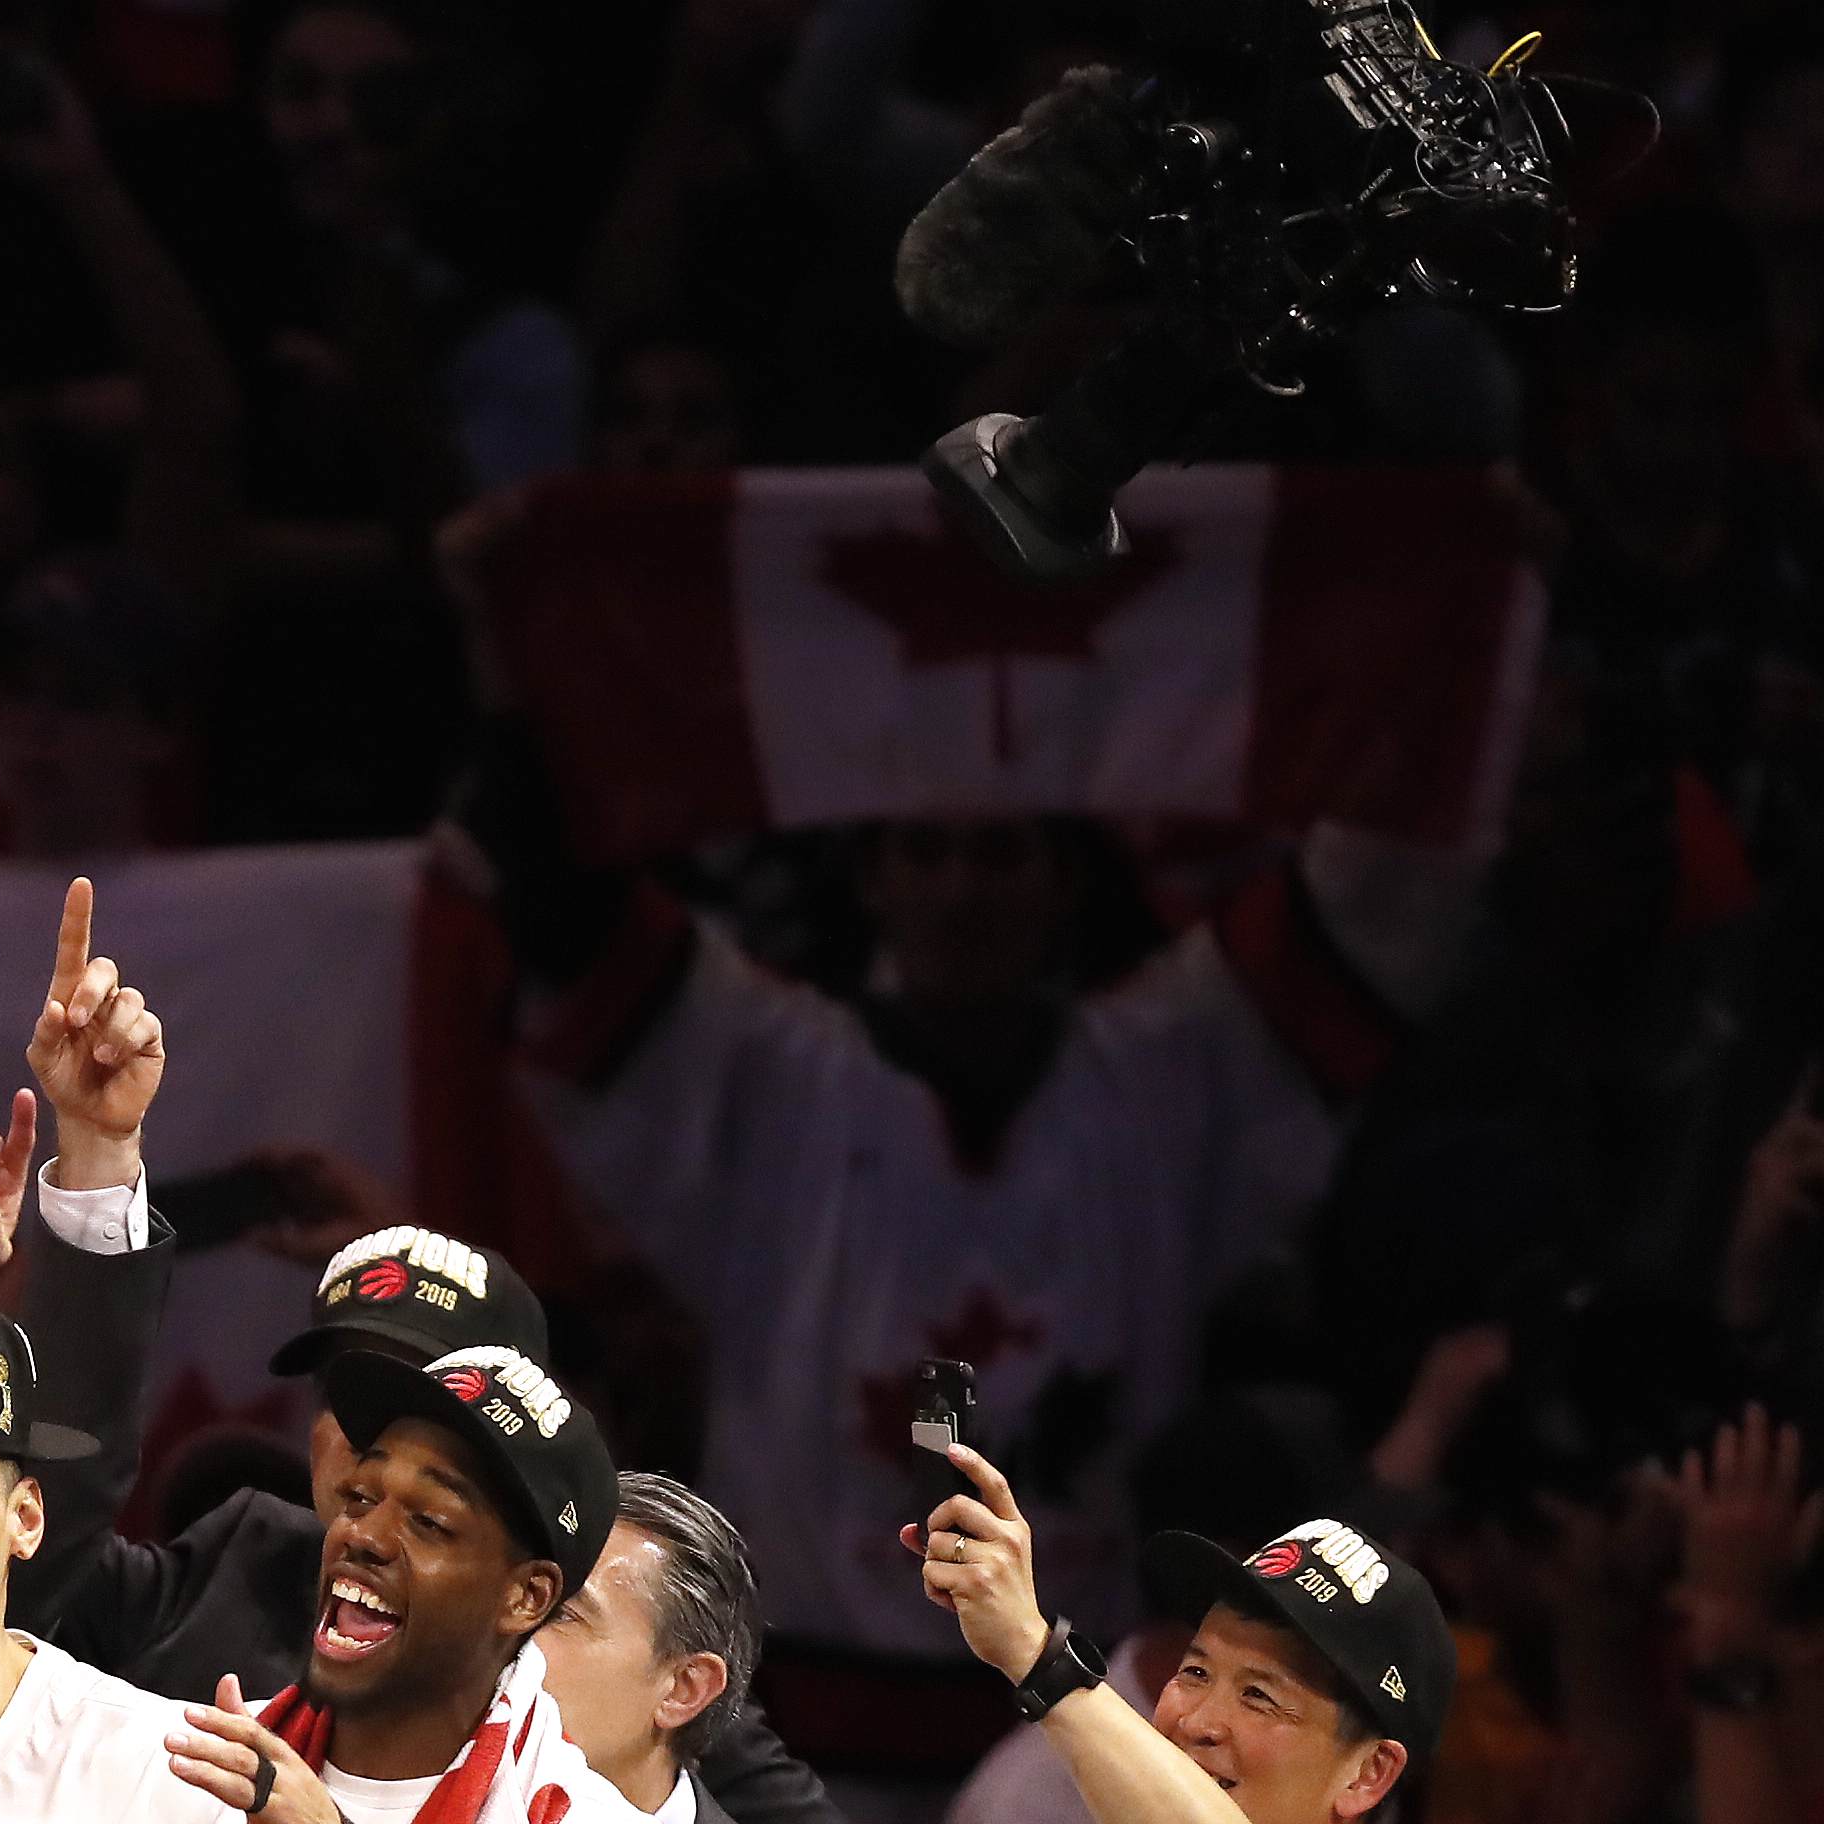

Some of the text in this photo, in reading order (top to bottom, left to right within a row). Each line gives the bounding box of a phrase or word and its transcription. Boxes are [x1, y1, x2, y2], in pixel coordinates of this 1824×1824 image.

[414, 1279, 459, 1311] 2019
[481, 1397, 525, 1436] 2019
[1294, 1567, 1339, 1603] 2019
